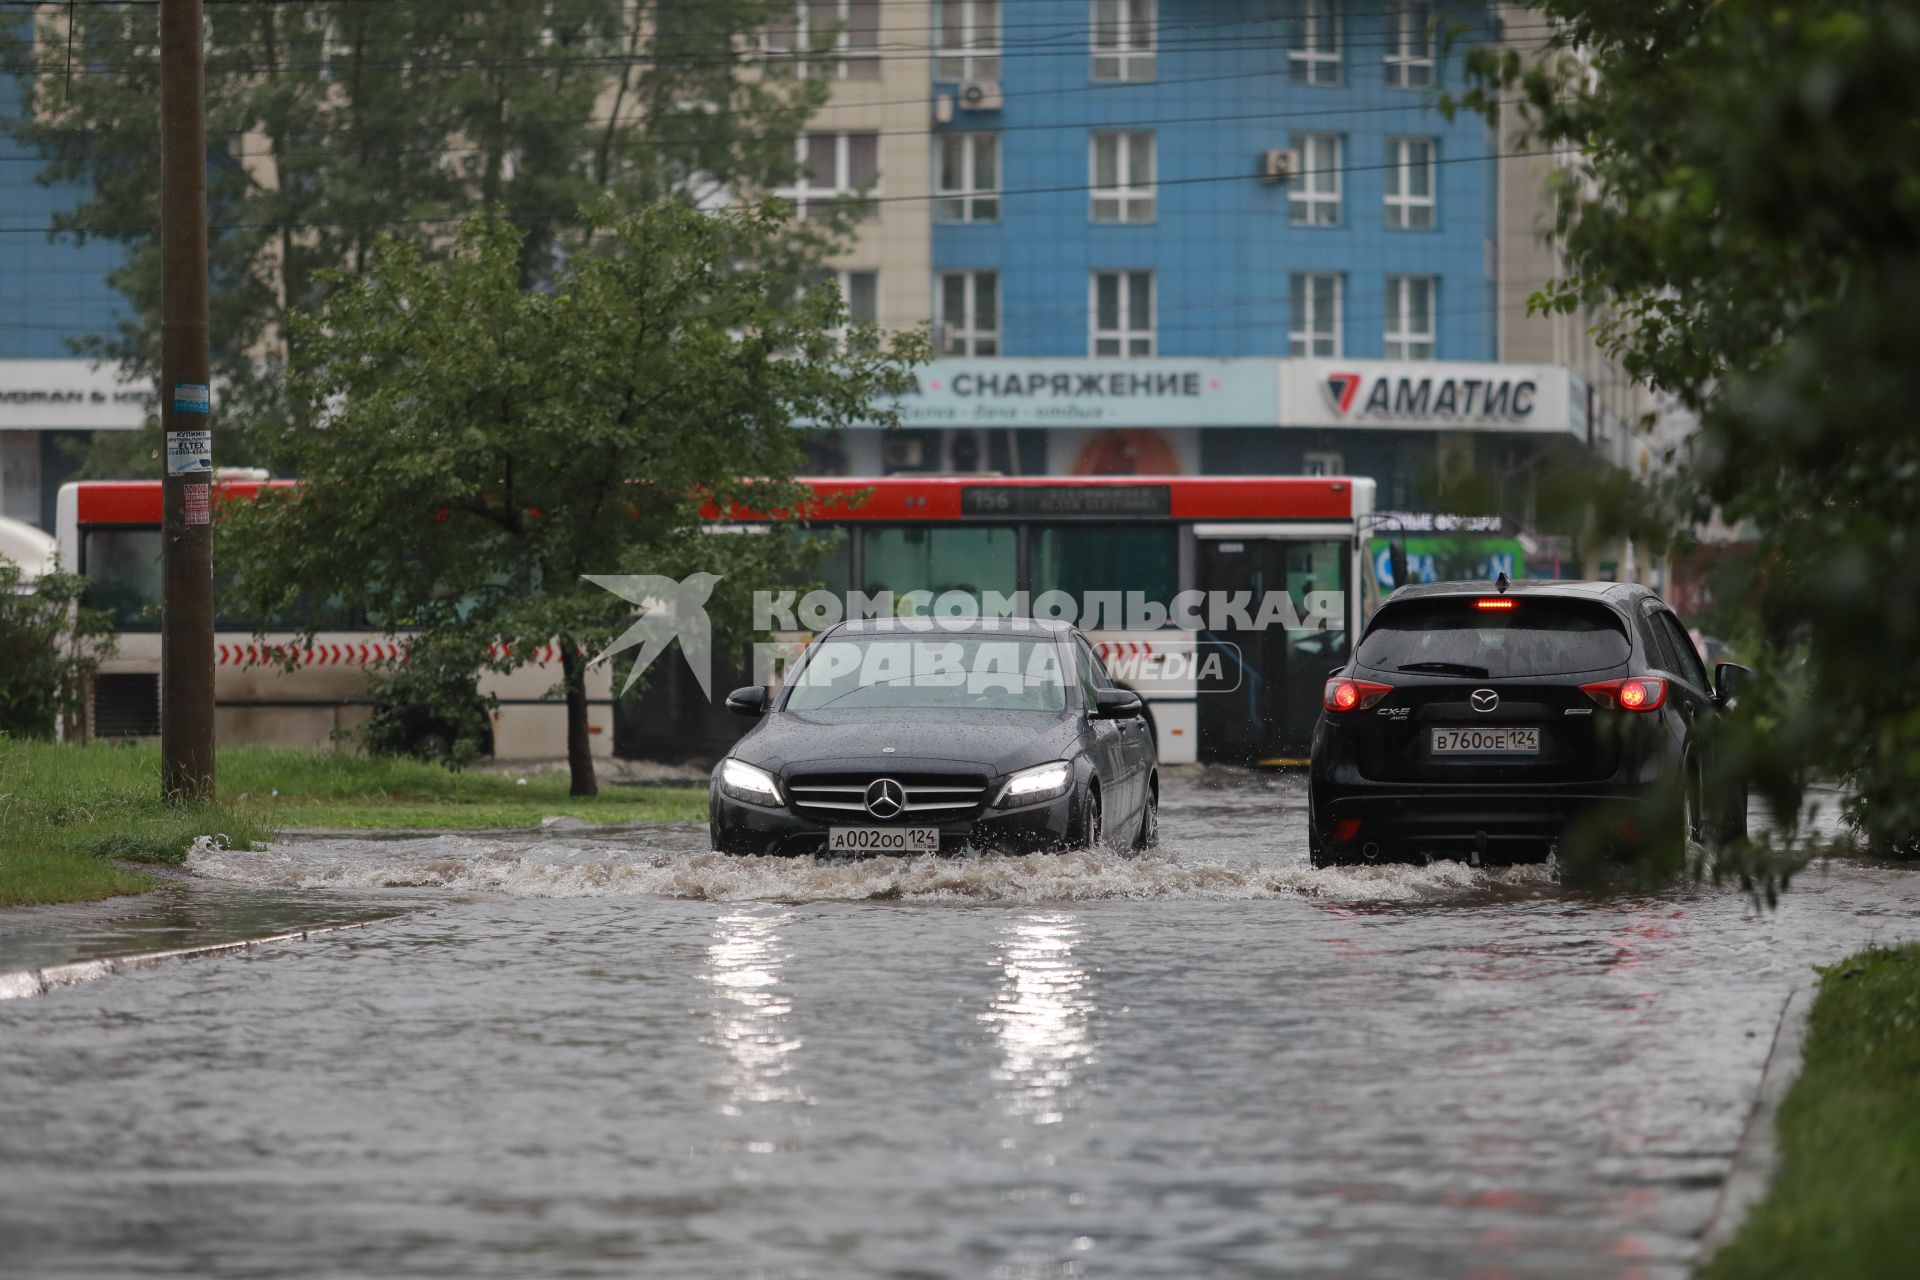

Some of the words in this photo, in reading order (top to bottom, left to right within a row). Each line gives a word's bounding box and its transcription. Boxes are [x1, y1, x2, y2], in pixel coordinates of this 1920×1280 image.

[951, 371, 1203, 397] СНАРЯЖЕНИЕ
[1364, 376, 1537, 417] АМАТИС
[971, 489, 1010, 510] 156
[1377, 707, 1411, 715] CX-5
[1509, 731, 1535, 745] 124
[908, 829, 936, 844] 124
